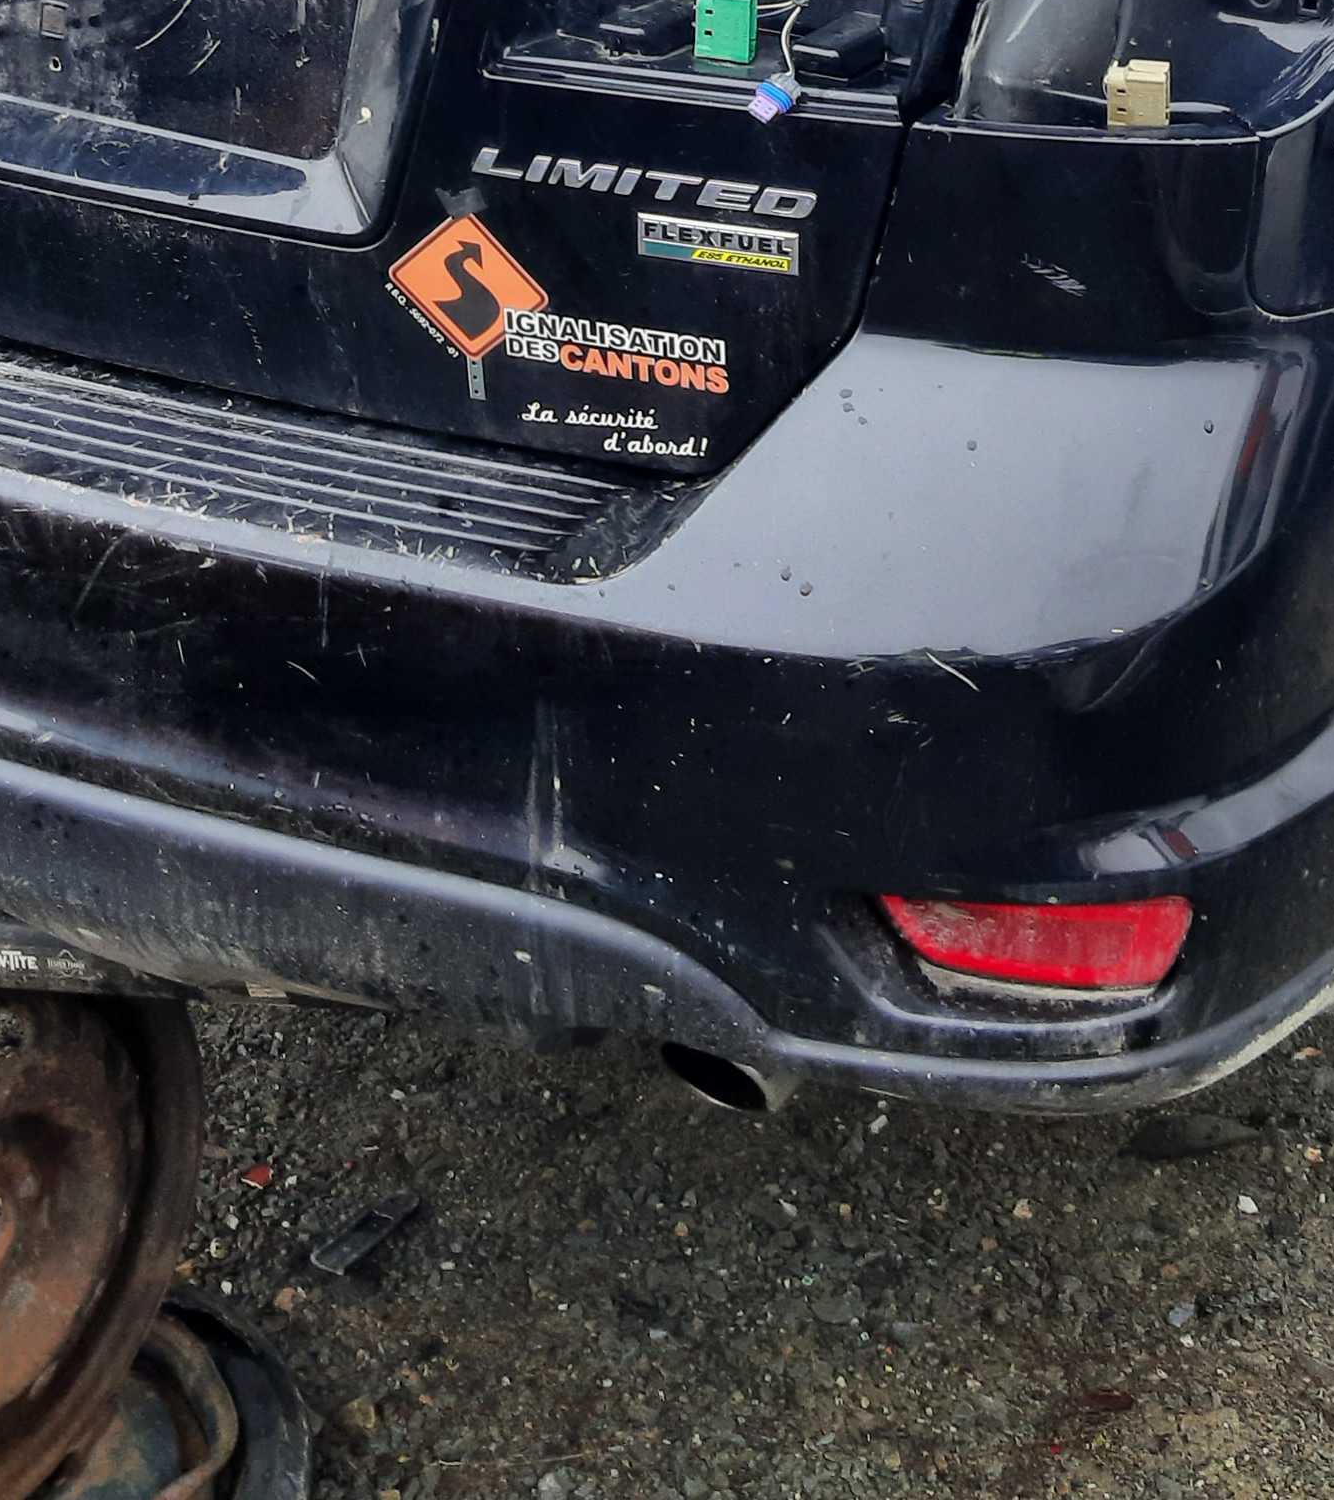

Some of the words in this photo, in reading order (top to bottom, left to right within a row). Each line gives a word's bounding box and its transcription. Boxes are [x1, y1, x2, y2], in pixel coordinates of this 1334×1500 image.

[471, 146, 818, 219] LIMITED
[643, 221, 793, 255] FLEXFUEL
[726, 252, 786, 269] ETHANOL
[507, 334, 560, 363] DES
[559, 344, 730, 394] CANTONS
[521, 402, 558, 423] La
[564, 404, 659, 430] sécurité
